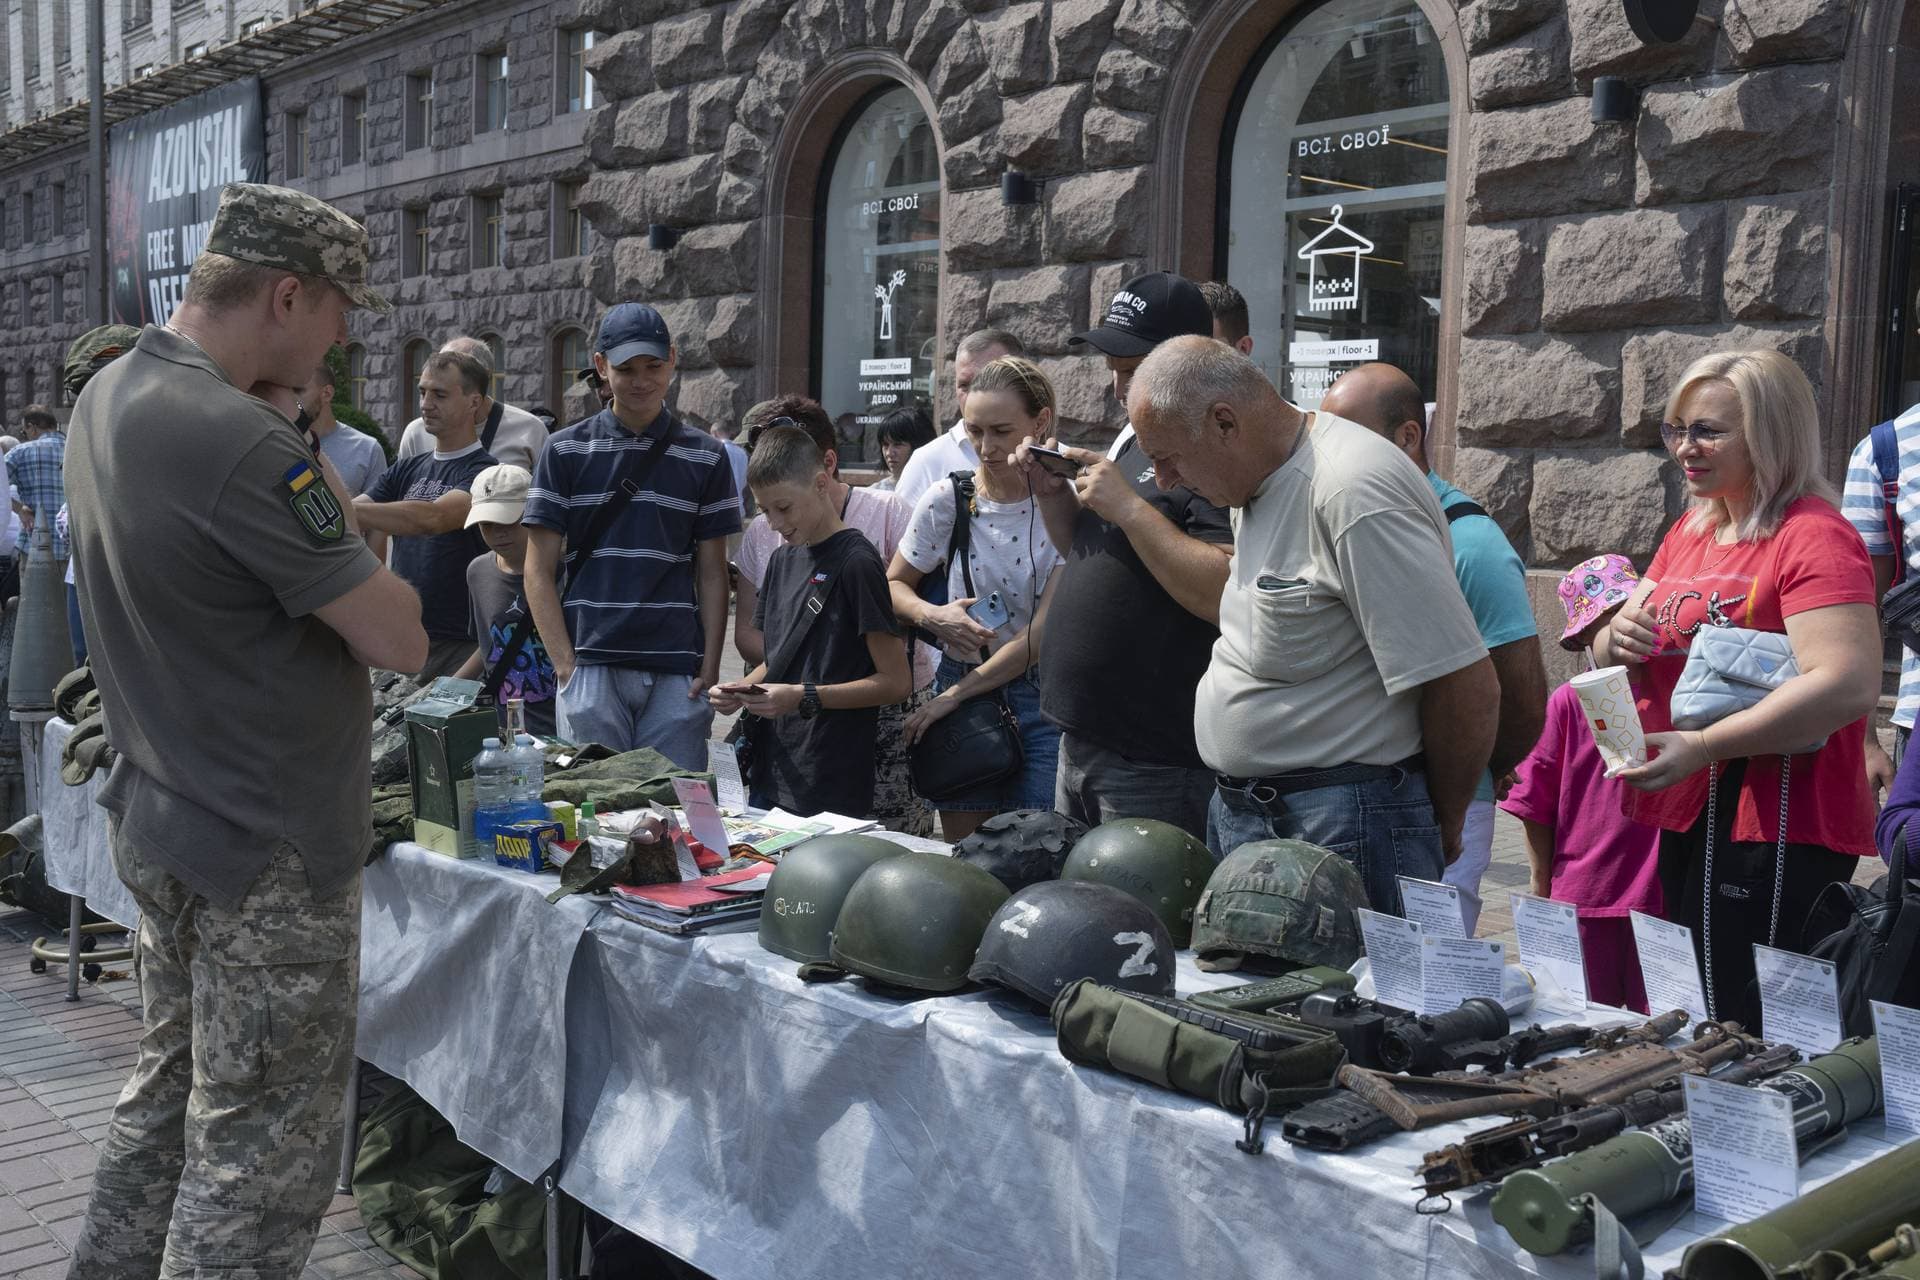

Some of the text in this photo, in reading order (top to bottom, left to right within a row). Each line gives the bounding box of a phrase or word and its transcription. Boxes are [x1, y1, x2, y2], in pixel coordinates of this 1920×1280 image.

[1298, 124, 1389, 157] ВСІ. СВОЇ
[148, 105, 247, 203] AZOVSTAL
[888, 193, 919, 211] СВОЇ
[148, 227, 175, 271] FREE
[1342, 345, 1363, 355] floor
[858, 379, 912, 391] УКРАЇНСЬКИЙ
[1289, 368, 1346, 384] УКРАЇНС
[872, 394, 898, 406] ДЕКОР
[1112, 931, 1158, 978] Z
